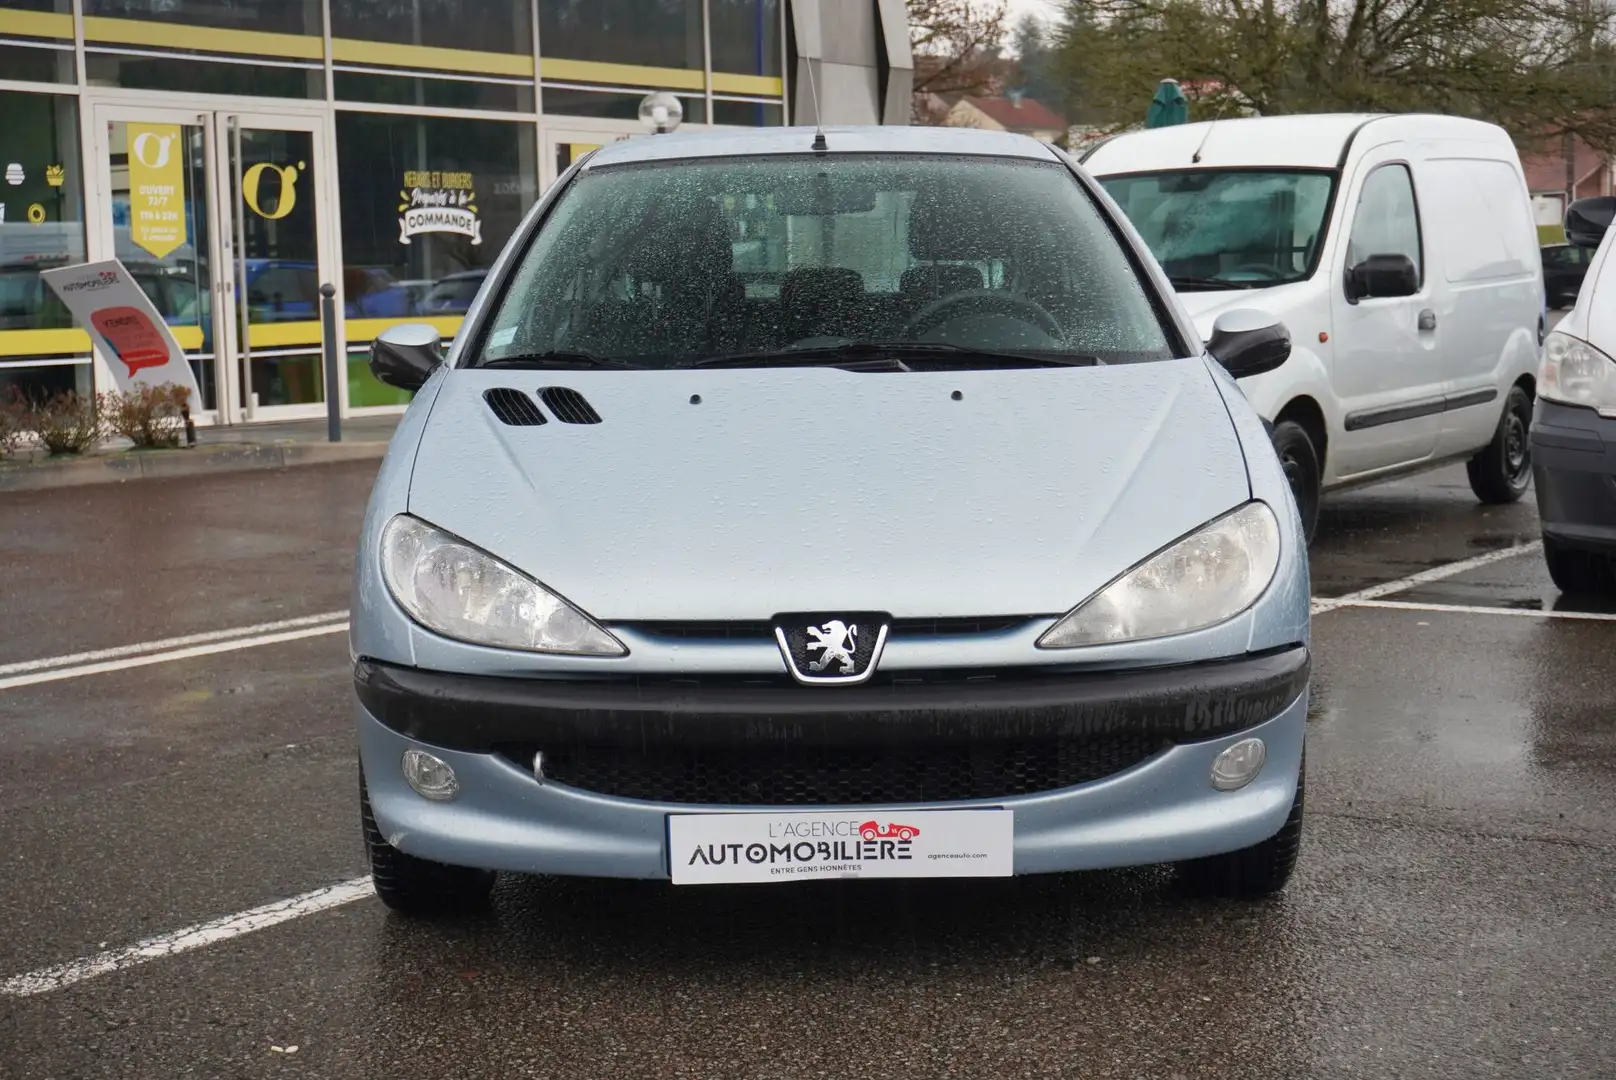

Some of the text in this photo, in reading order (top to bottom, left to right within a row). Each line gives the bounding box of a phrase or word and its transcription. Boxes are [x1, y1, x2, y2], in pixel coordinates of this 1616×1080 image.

[432, 171, 441, 188] ET
[139, 185, 175, 196] OUVERT
[408, 213, 472, 230] COMMANDE
[768, 820, 859, 838] L'AGENCE
[688, 840, 913, 866] AUTOMOBILIERE
[927, 852, 988, 860] agenceauto.com
[770, 863, 862, 875] ENTRE GENS HONNÊTES
